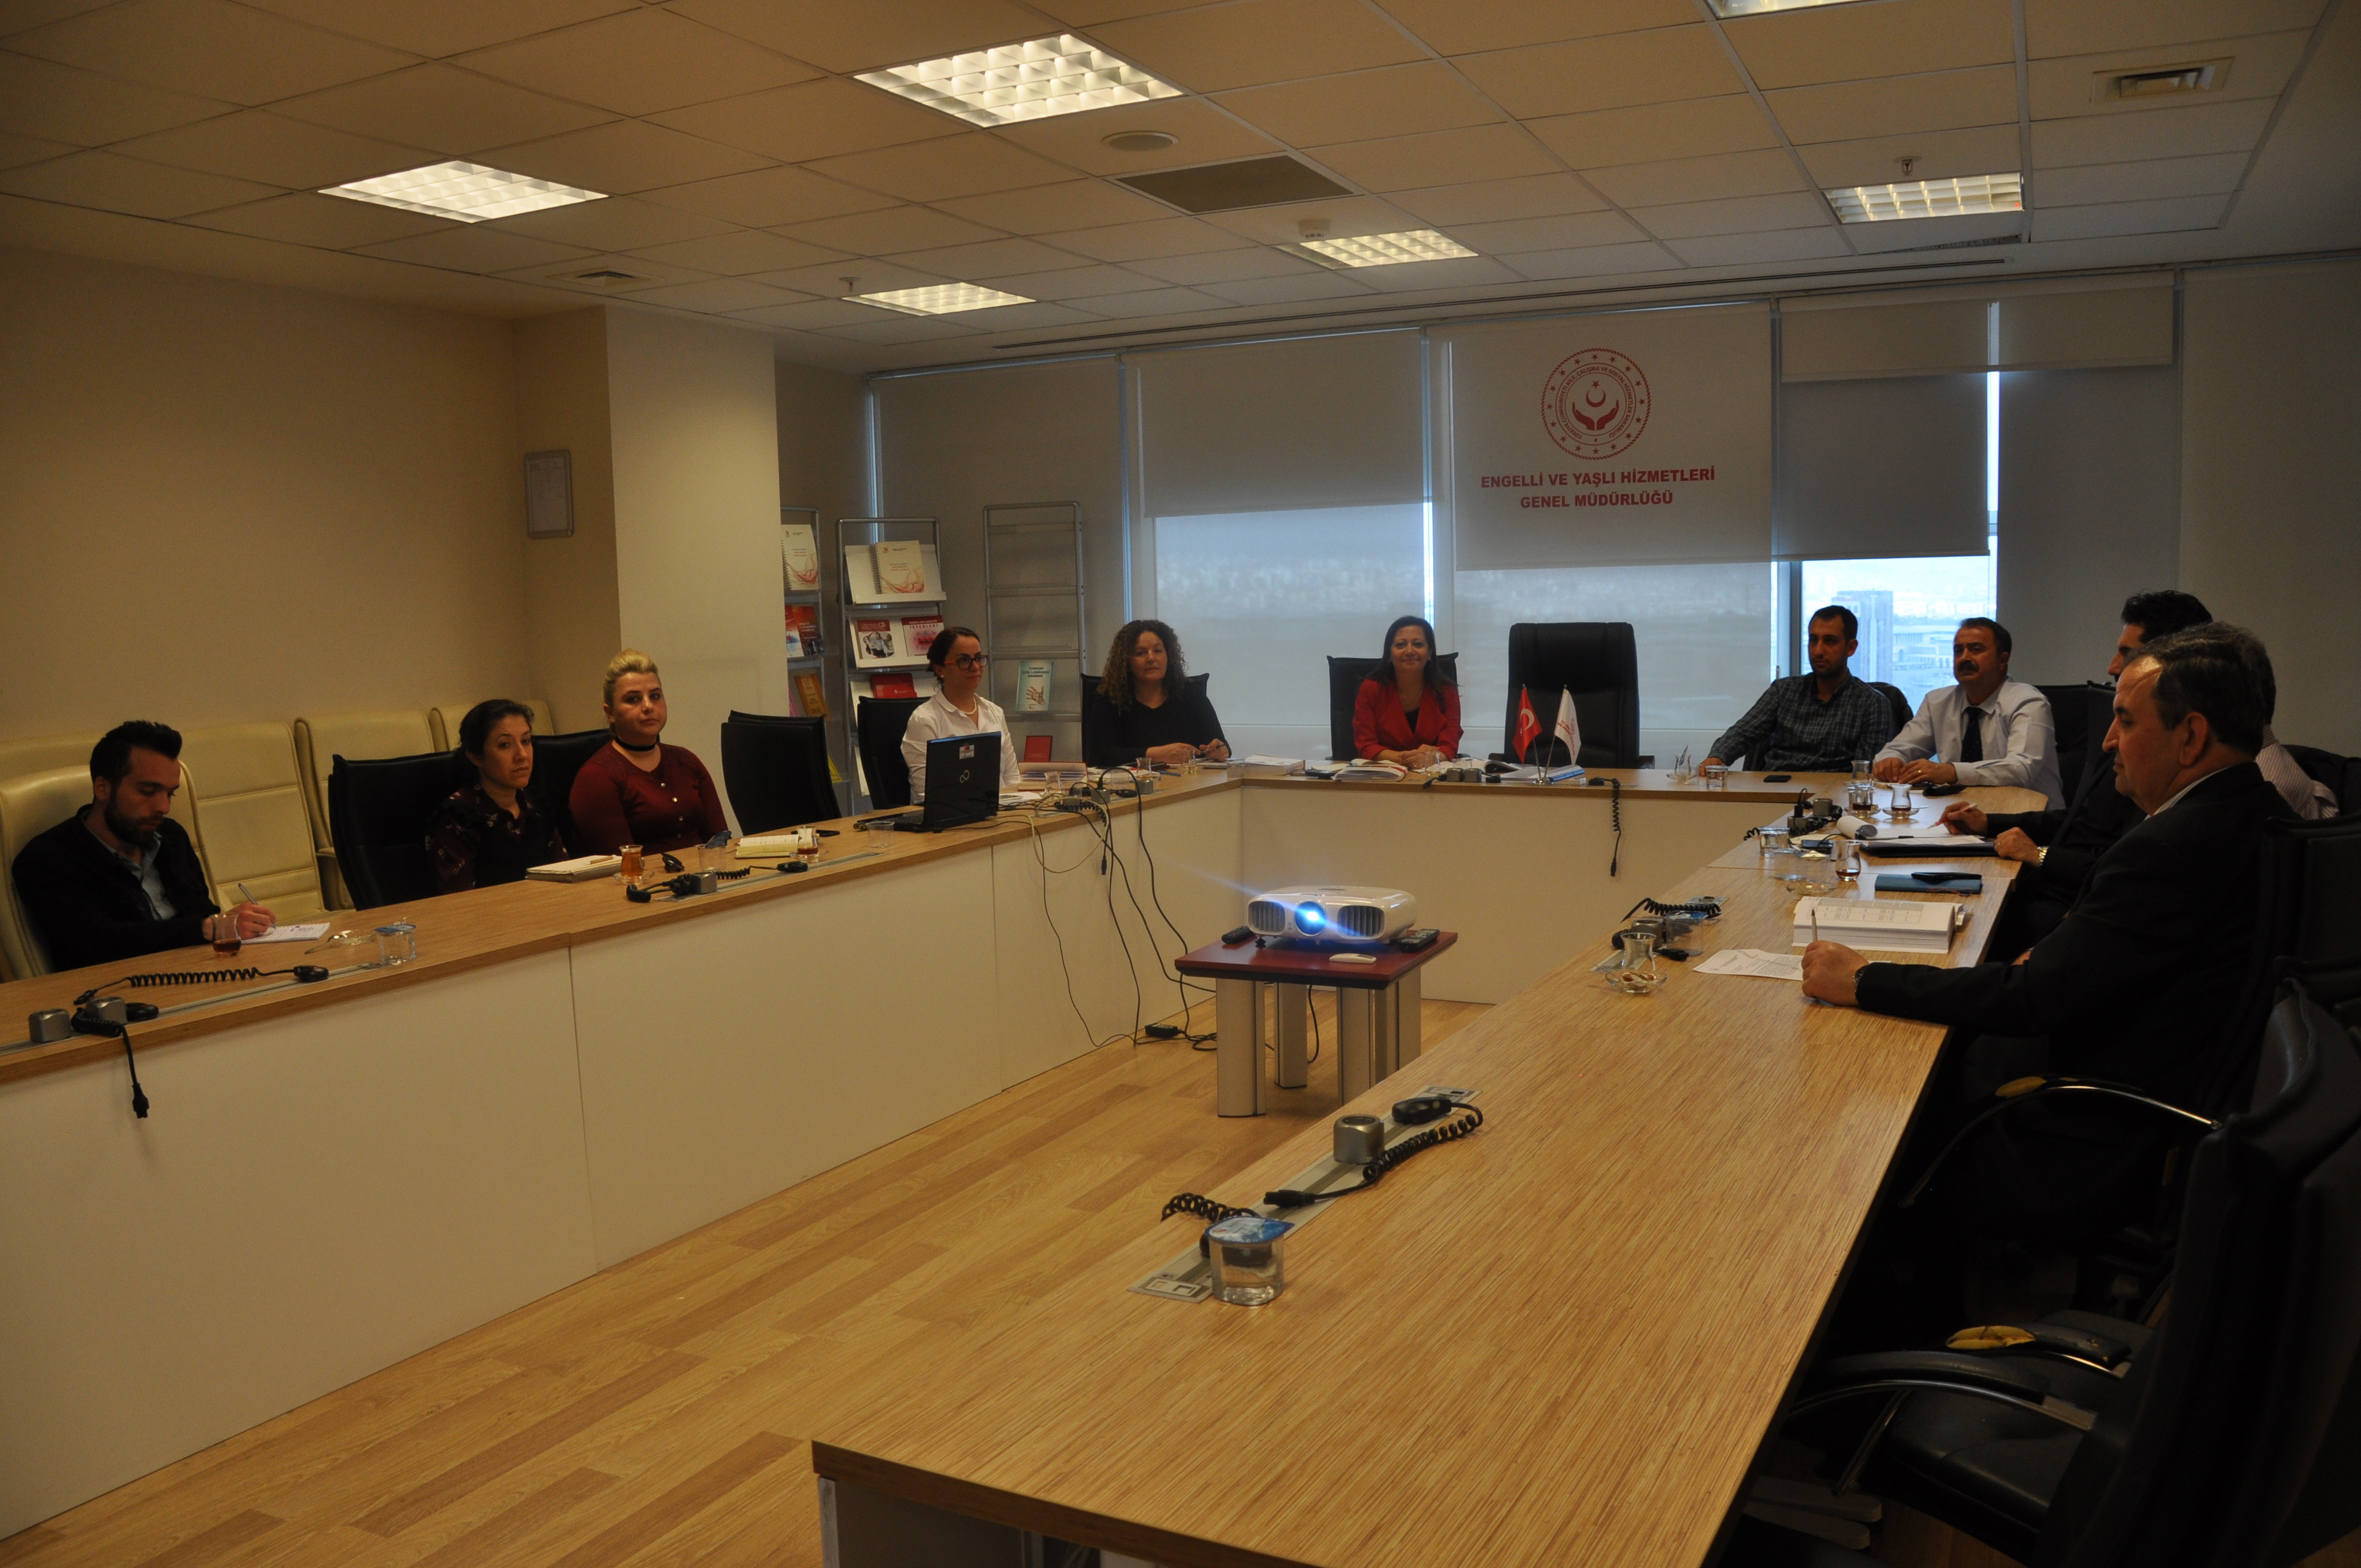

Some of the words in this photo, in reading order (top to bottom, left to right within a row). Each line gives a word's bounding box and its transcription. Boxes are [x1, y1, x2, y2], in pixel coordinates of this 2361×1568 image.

[1576, 366, 1600, 377] ÇALIŞMA
[1608, 368, 1625, 384] SOSYAL
[1624, 383, 1633, 413] HİZMETLER
[1481, 471, 1543, 488] ENGELLİ
[1548, 473, 1568, 486] VE
[1573, 472, 1615, 487] YAŞLI
[1620, 465, 1715, 483] HİZMETLERİ
[1520, 495, 1570, 509] GENEL
[1574, 489, 1674, 507] MÜDÜRLÜĞÜ
